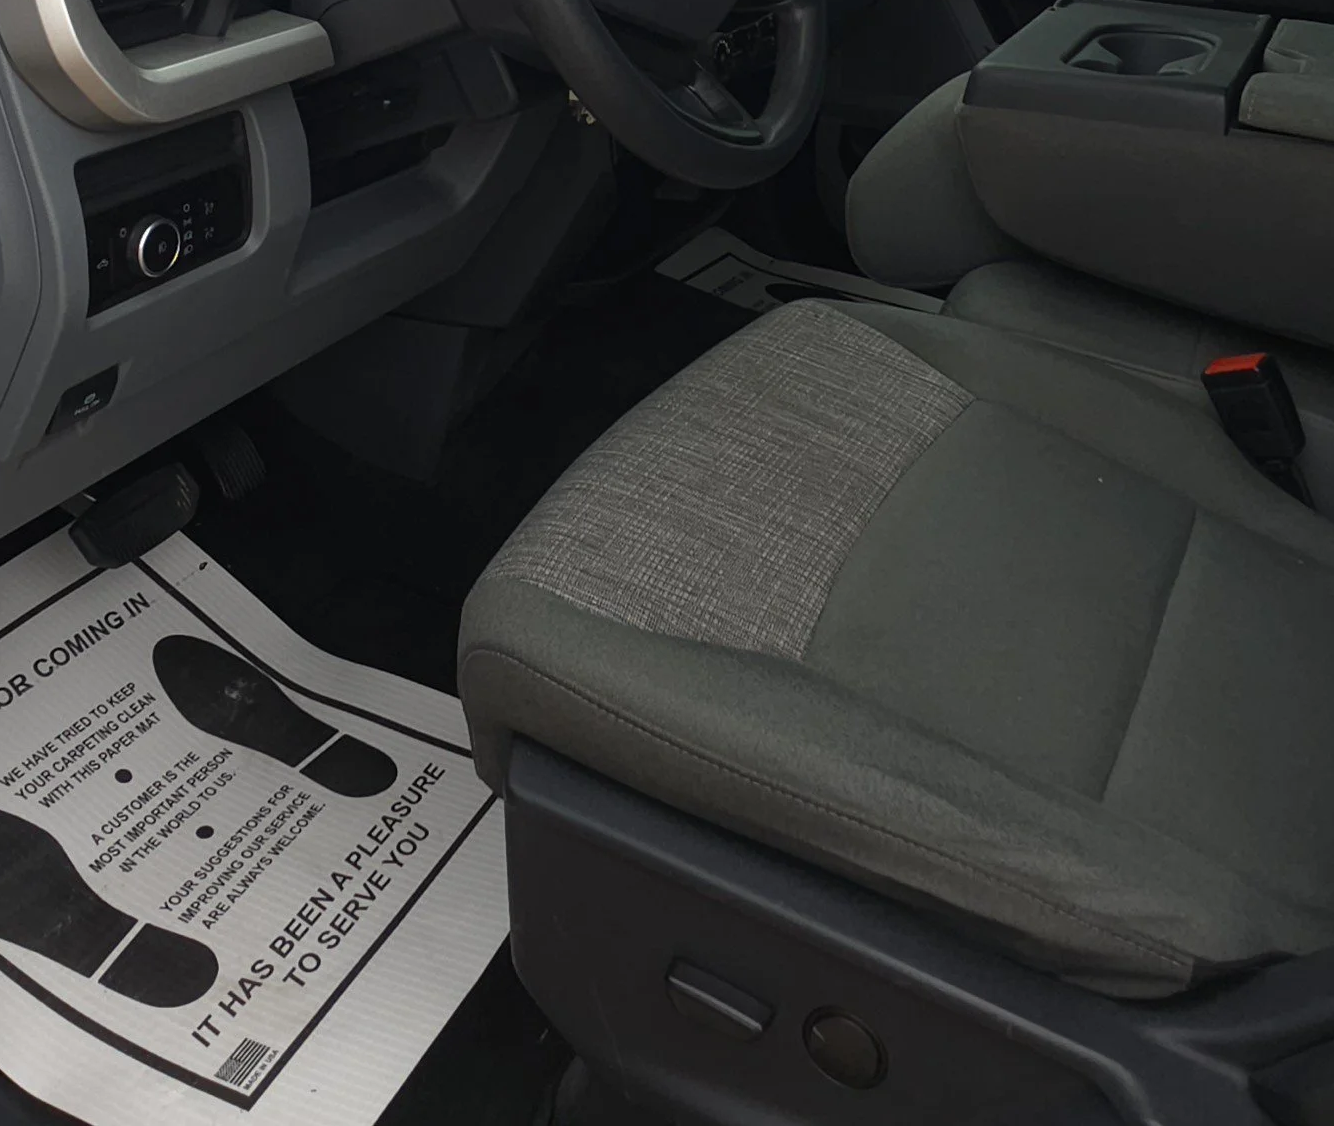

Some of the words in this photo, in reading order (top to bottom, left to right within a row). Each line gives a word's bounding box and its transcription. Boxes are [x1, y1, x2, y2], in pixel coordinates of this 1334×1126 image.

[32, 610, 125, 678] COMING
[123, 592, 151, 620] IN
[0, 766, 25, 788] WE
[22, 742, 58, 771] HAVE
[54, 716, 92, 746] TRIED
[88, 703, 109, 720] TO
[106, 682, 136, 707] KEEP
[14, 770, 55, 801] YOUR
[53, 720, 119, 773] CARPETING
[117, 692, 156, 724] CLEAN
[38, 779, 75, 808] WITH
[71, 759, 101, 784] THIS
[100, 731, 139, 763] PAPER
[136, 711, 161, 734] MAT
[88, 839, 127, 873] MOST
[124, 784, 190, 843] IMPORTANT
[186, 748, 233, 788] PERSON
[90, 833, 105, 846] A
[101, 780, 167, 835] CUSTOMER
[162, 770, 178, 788] IS
[174, 751, 200, 775] THE
[119, 857, 138, 873] IN
[131, 836, 162, 864] THE
[156, 801, 202, 839] WORLD
[197, 785, 217, 804] TO
[159, 880, 199, 913] YOUR
[194, 806, 271, 880] SUGGESTIONS
[268, 784, 295, 808] FOR
[178, 859, 244, 924] IMPROVING
[241, 835, 269, 859] OUR
[264, 791, 311, 836] SERVICE
[191, 1014, 221, 1047] IT
[218, 959, 275, 1017] HAS
[269, 888, 335, 959] BEEN
[331, 870, 353, 891] A
[345, 762, 446, 871] PLEASURE
[202, 902, 231, 930] ARE
[226, 857, 273, 903] ALWAYS
[268, 803, 326, 856] WELCOME.
[282, 952, 322, 989] TO
[318, 870, 391, 949] SERVE
[382, 822, 430, 870] YOU
[243, 1070, 262, 1090] MADE
[264, 1049, 279, 1063] USA
